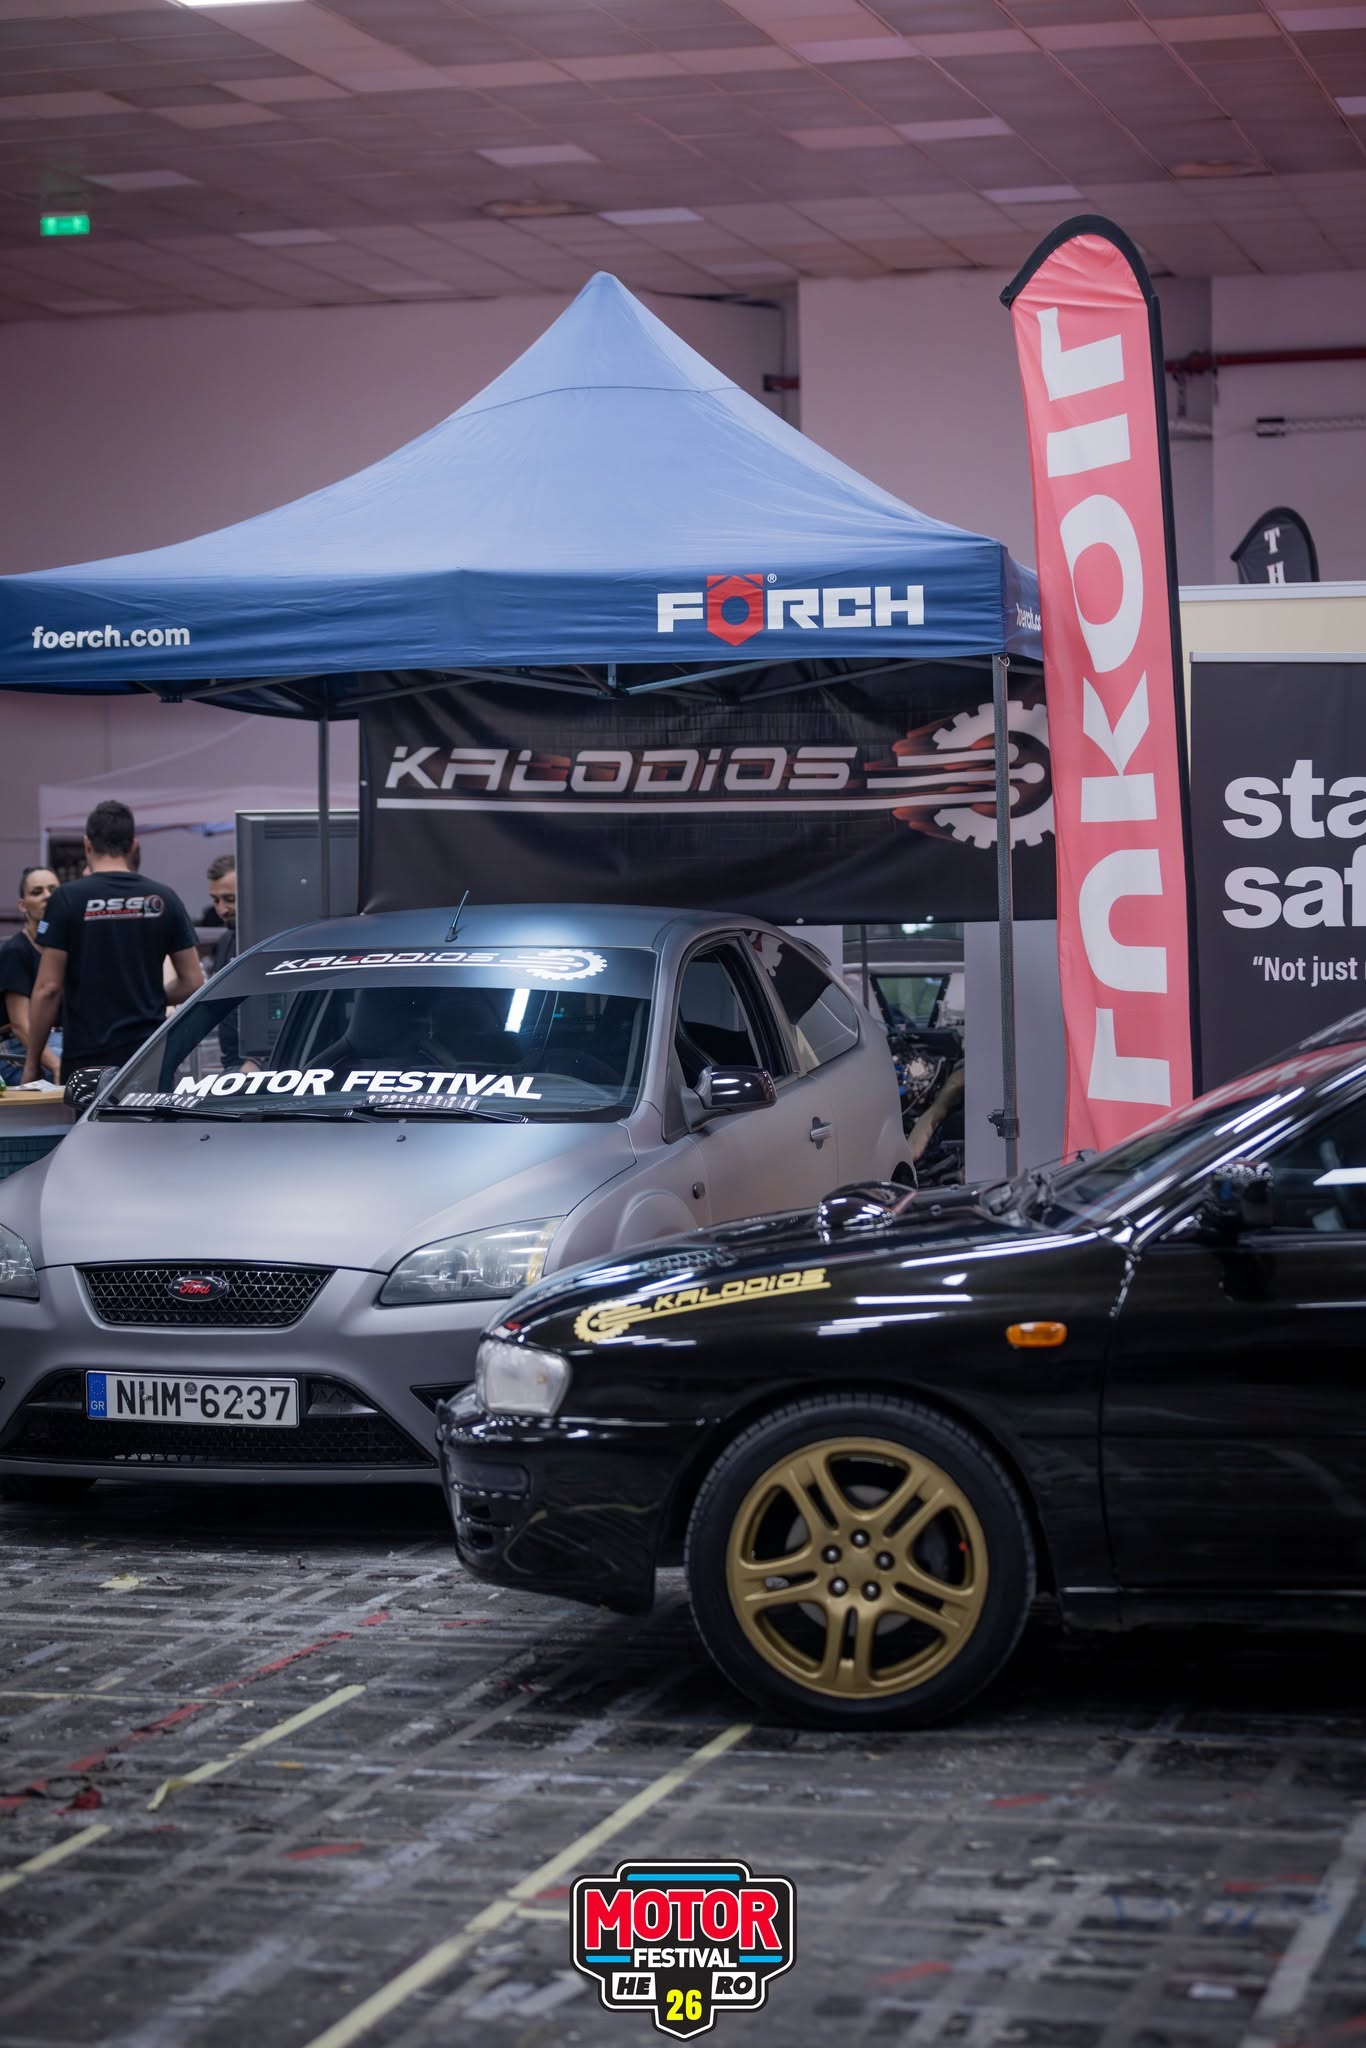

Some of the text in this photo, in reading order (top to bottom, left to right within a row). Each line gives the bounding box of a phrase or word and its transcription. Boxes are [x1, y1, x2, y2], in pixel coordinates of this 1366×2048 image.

[32, 624, 190, 648] foerch.com
[1311, 956, 1358, 987] just
[173, 1069, 542, 1100] MOTOR FESTIVAL
[179, 1280, 211, 1294] Ford
[91, 1401, 105, 1411] GR
[116, 1379, 290, 1421] NHM-6237
